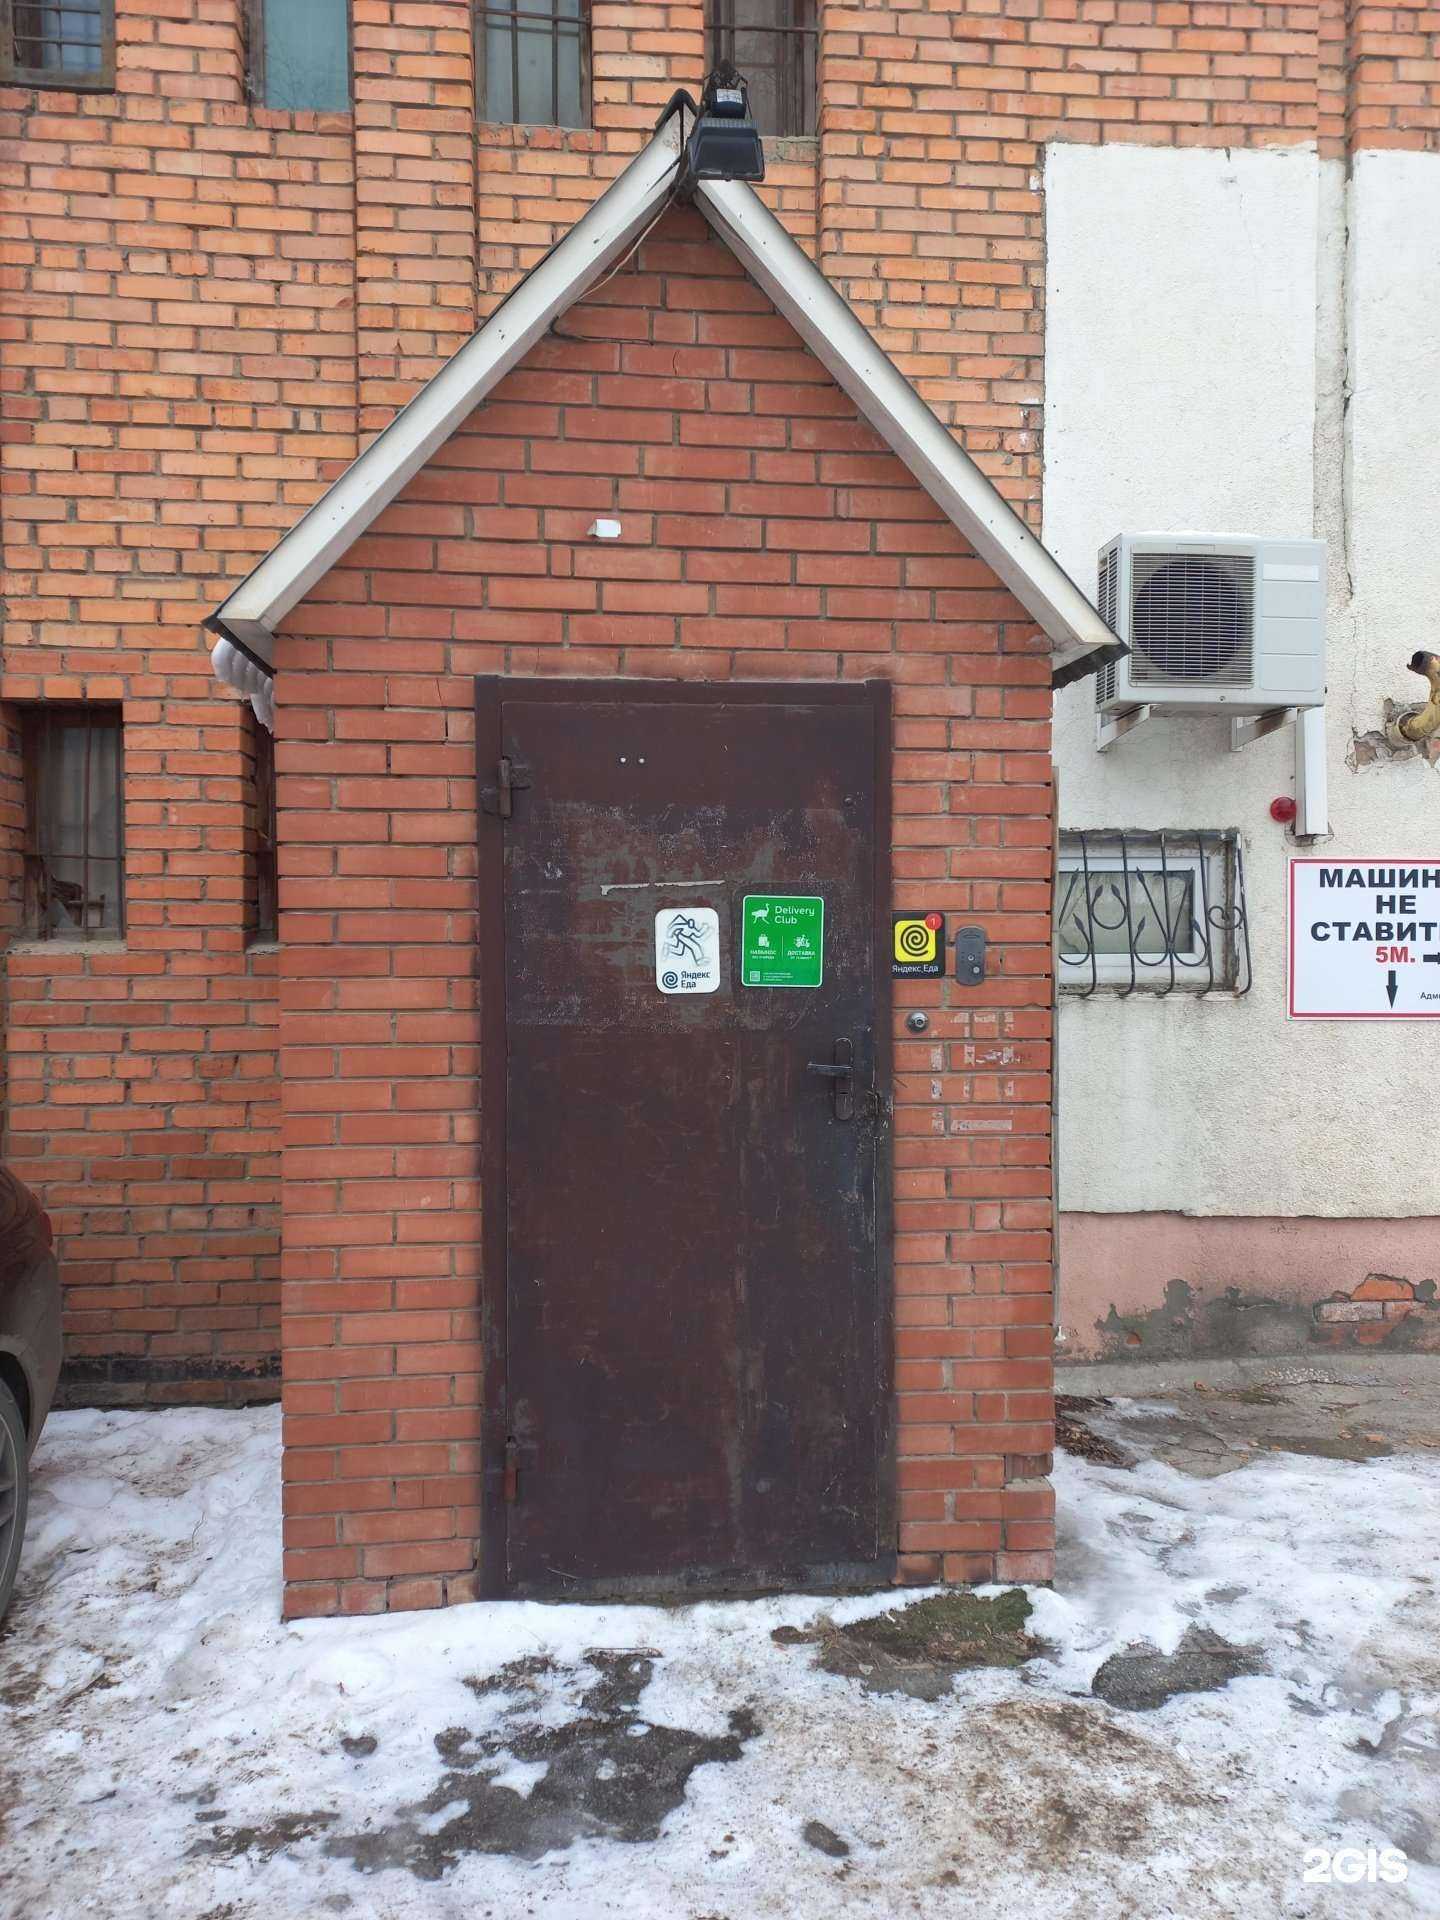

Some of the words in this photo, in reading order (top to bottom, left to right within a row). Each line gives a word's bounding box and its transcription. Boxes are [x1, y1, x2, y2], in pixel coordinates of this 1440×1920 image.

[1376, 895, 1416, 914] НЕ
[775, 906, 815, 917] Delivery
[775, 915, 797, 925] Club
[1311, 922, 1440, 941] СТАВИТ
[1376, 947, 1415, 963] 5М.
[681, 971, 710, 980] Яндекс
[681, 980, 696, 989] Еда
[1420, 992, 1440, 1001] Адм
